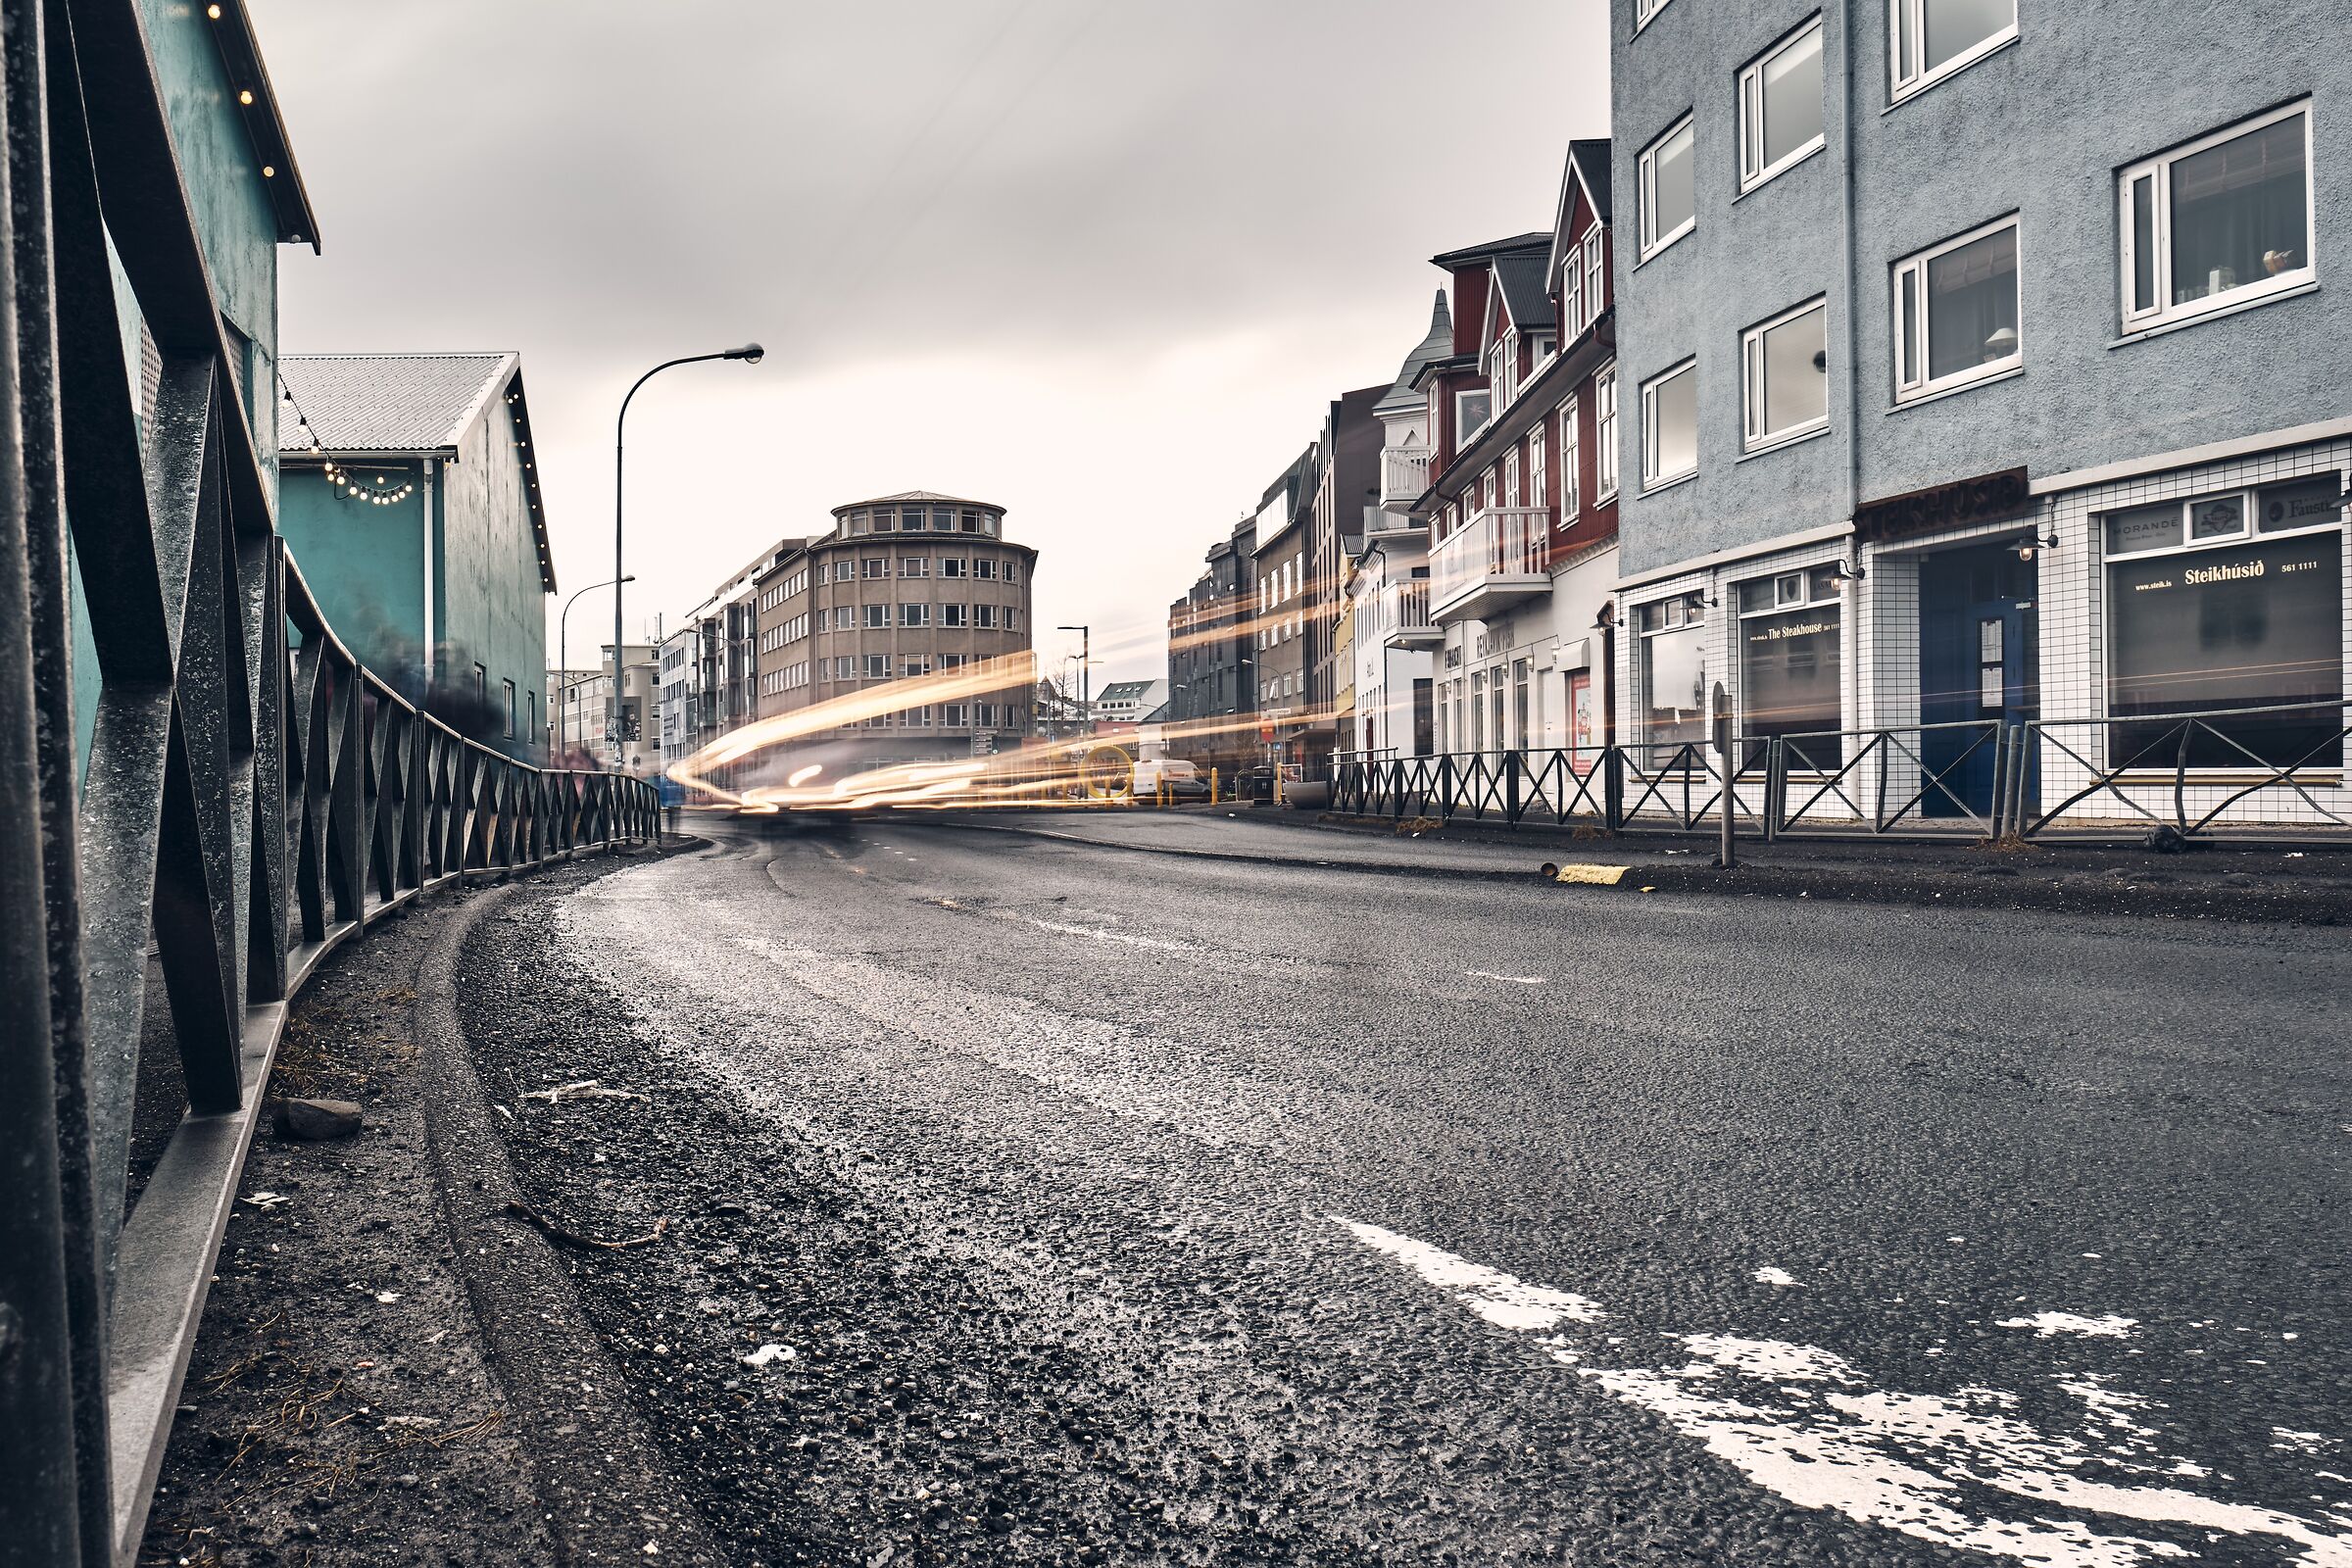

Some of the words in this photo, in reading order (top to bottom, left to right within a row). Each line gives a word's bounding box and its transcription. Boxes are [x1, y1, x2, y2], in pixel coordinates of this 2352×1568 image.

[2288, 496, 2340, 518] Fausti
[2134, 579, 2173, 591] www.steik.is
[2184, 560, 2264, 585] Steikhúsið
[2281, 564, 2296, 573] 561
[2298, 561, 2318, 570] 1111
[1768, 628, 1781, 640] The
[1782, 622, 1823, 638] Steakhouse
